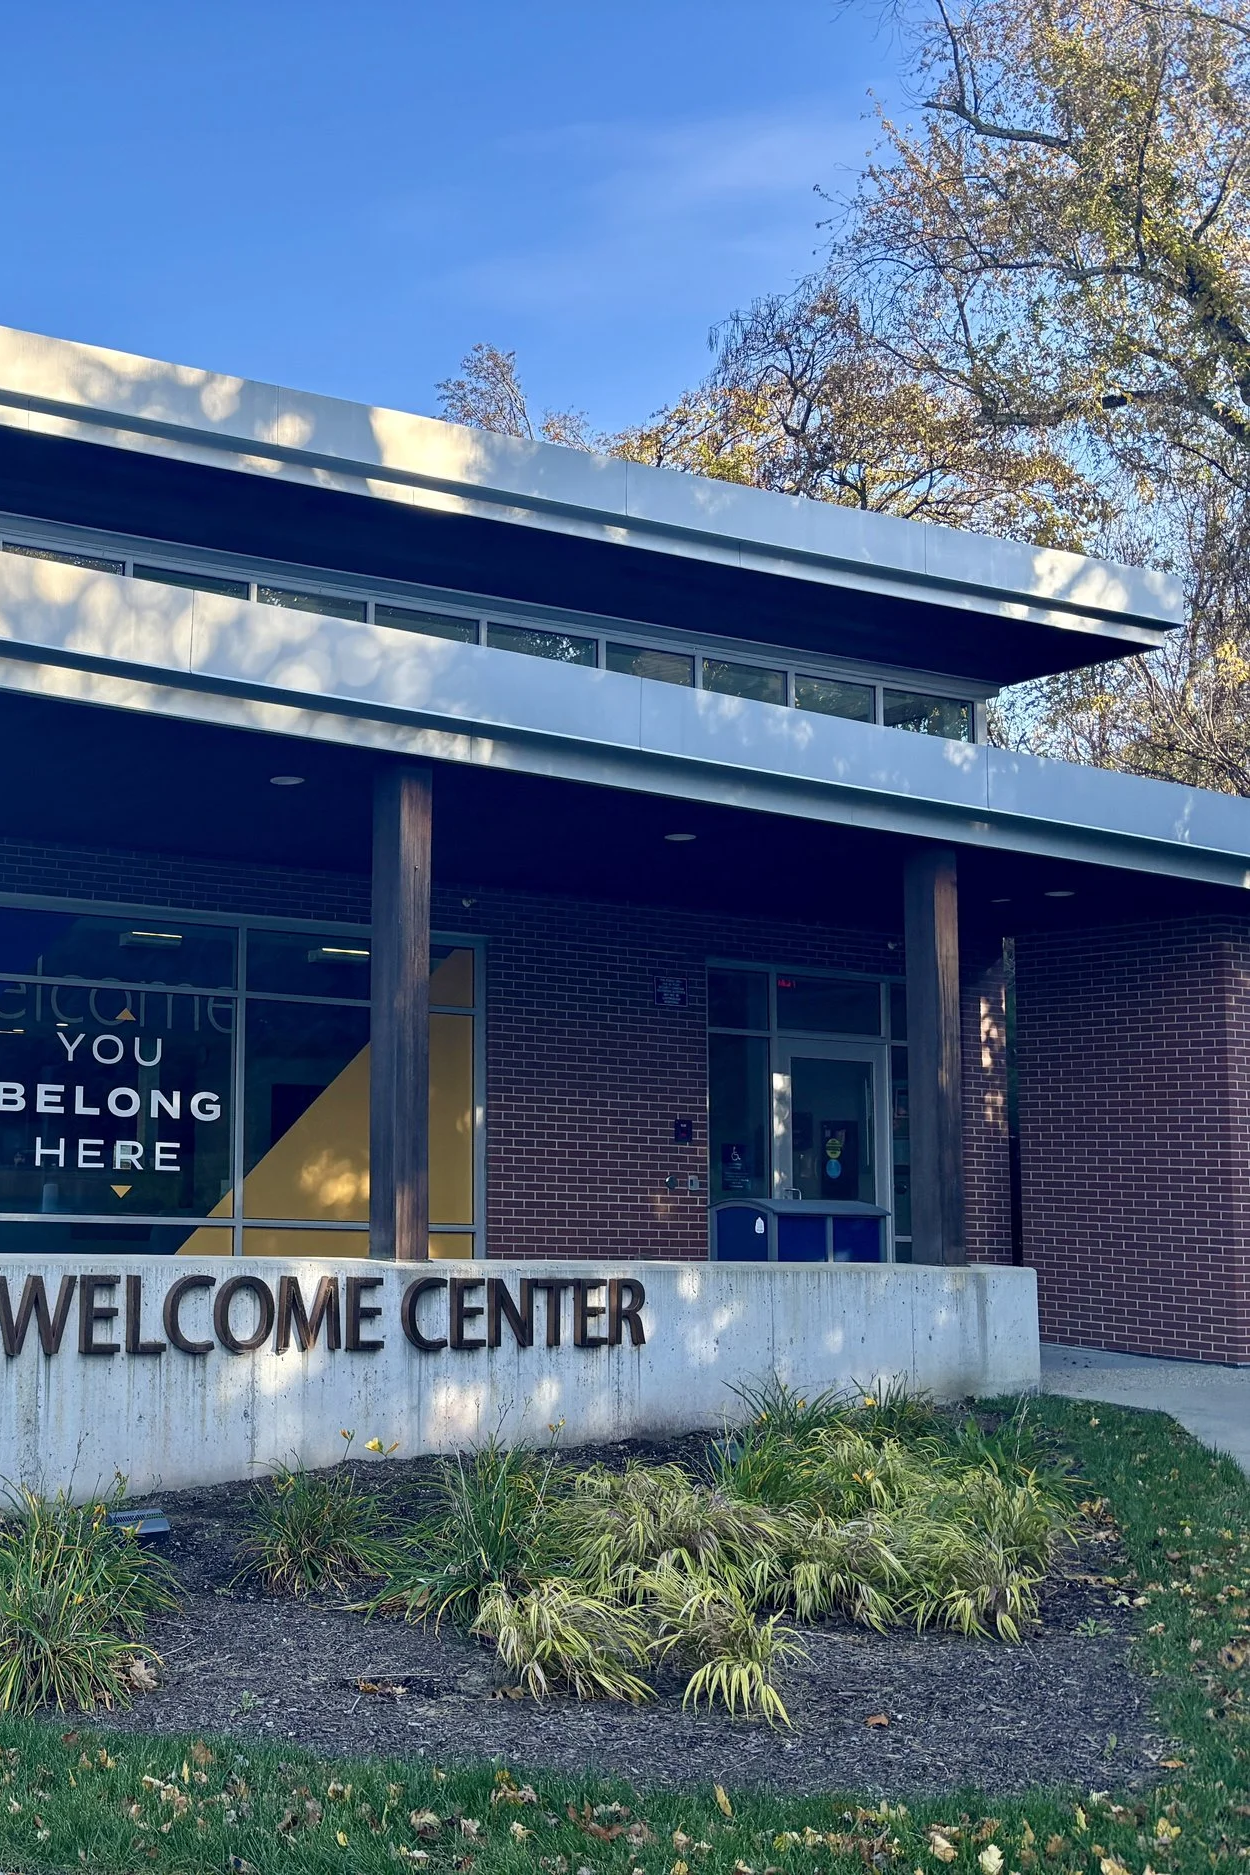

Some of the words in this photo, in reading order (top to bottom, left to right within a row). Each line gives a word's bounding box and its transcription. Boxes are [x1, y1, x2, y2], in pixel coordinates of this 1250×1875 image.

[56, 1031, 163, 1067] YOU
[34, 1136, 181, 1172] HERE
[400, 1276, 647, 1352] CENTER
